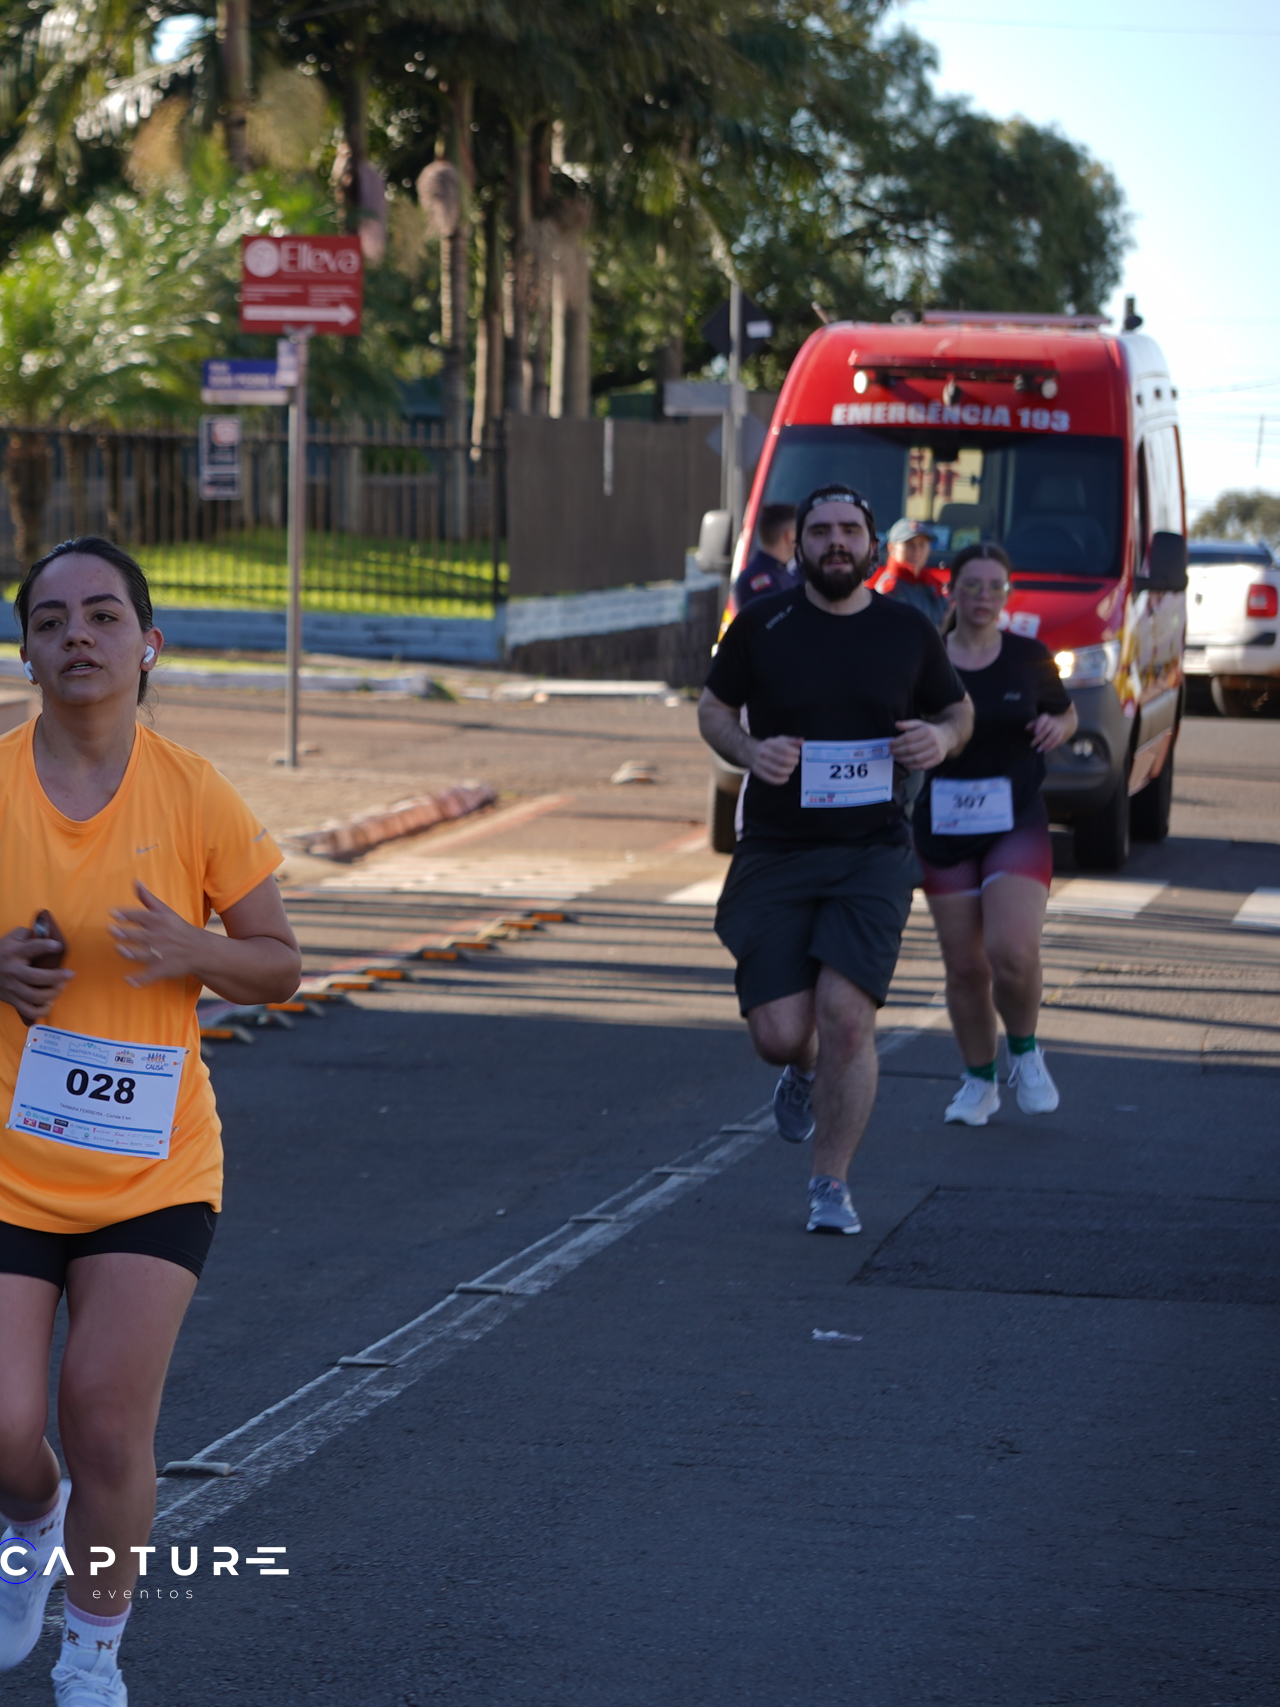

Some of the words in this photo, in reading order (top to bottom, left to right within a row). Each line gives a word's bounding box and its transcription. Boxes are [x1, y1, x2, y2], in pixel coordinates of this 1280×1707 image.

[280, 241, 361, 274] Elleva
[830, 399, 1011, 427] EMERGÊNCIA
[1017, 407, 1071, 432] 193
[829, 763, 869, 780] 236
[145, 1063, 164, 1071] CAUSA
[66, 1068, 136, 1105] 028
